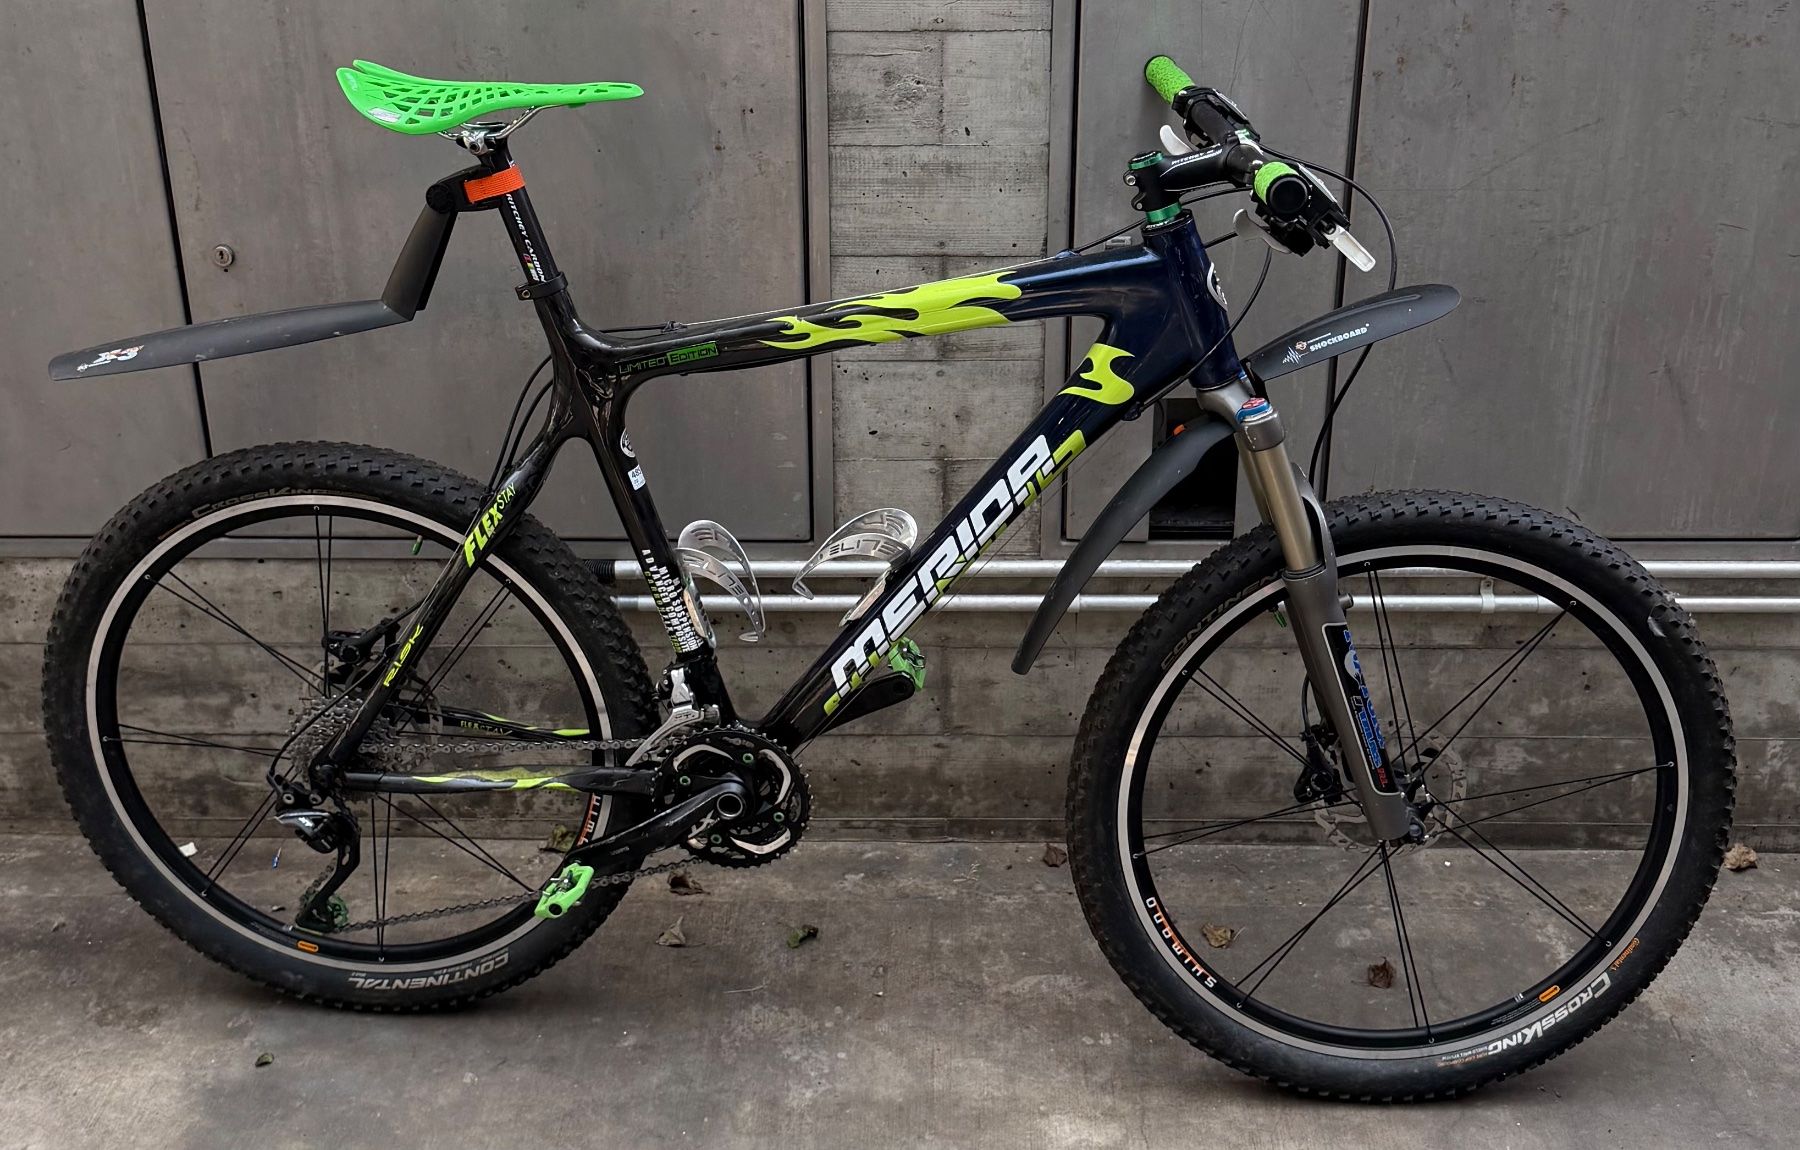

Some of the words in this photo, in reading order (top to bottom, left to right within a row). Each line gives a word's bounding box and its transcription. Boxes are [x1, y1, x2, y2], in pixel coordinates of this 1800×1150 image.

[505, 193, 529, 238] RITCHEY
[524, 239, 547, 283] CARBON
[619, 356, 666, 374] LIMITED
[669, 345, 717, 363] EDITION
[1309, 326, 1368, 352] SHOCKBOARD
[641, 549, 671, 604] ADVANCED
[665, 605, 692, 654] COMPOSITE
[658, 566, 679, 599] MICRO
[672, 599, 700, 652] SUSPENSION
[830, 434, 1056, 698] MERIDA
[348, 951, 510, 990] CONTINENTAL
